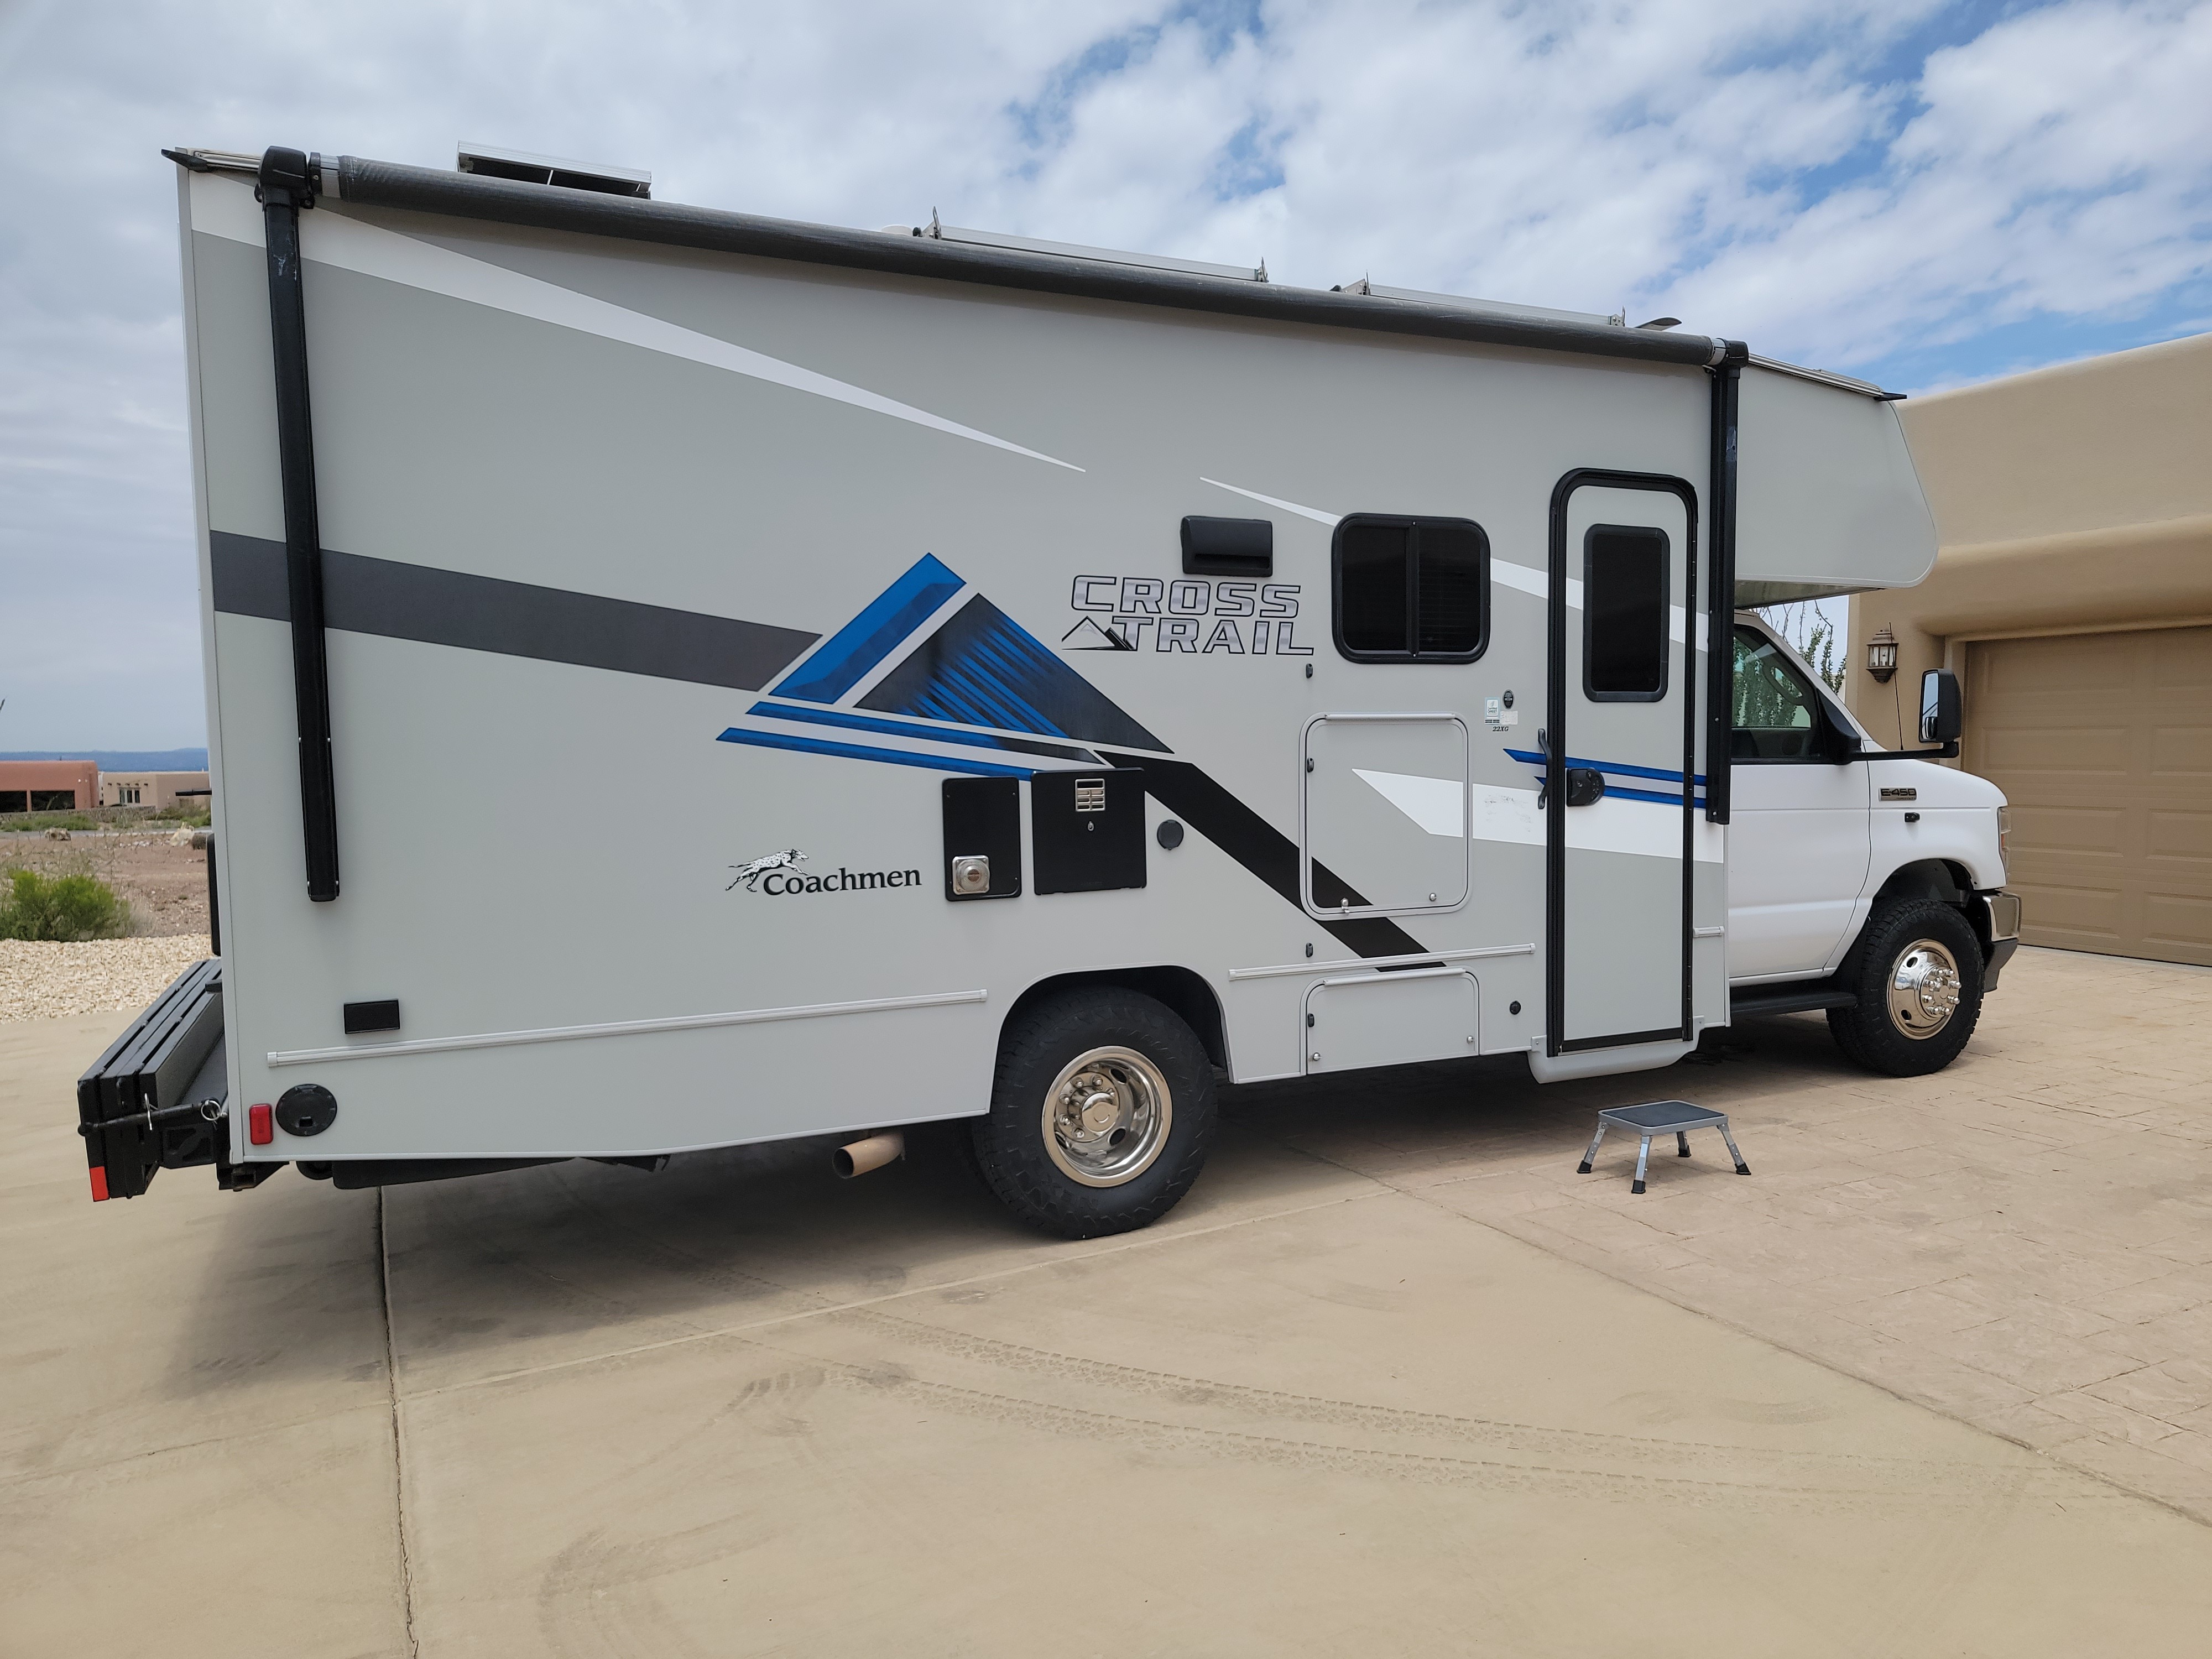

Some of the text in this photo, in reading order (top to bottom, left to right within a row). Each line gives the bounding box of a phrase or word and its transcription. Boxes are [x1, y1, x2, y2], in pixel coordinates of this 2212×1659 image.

[1071, 575, 1301, 618] CROSS
[1112, 615, 1314, 655] TRAIL
[763, 867, 922, 895] Coachmen
